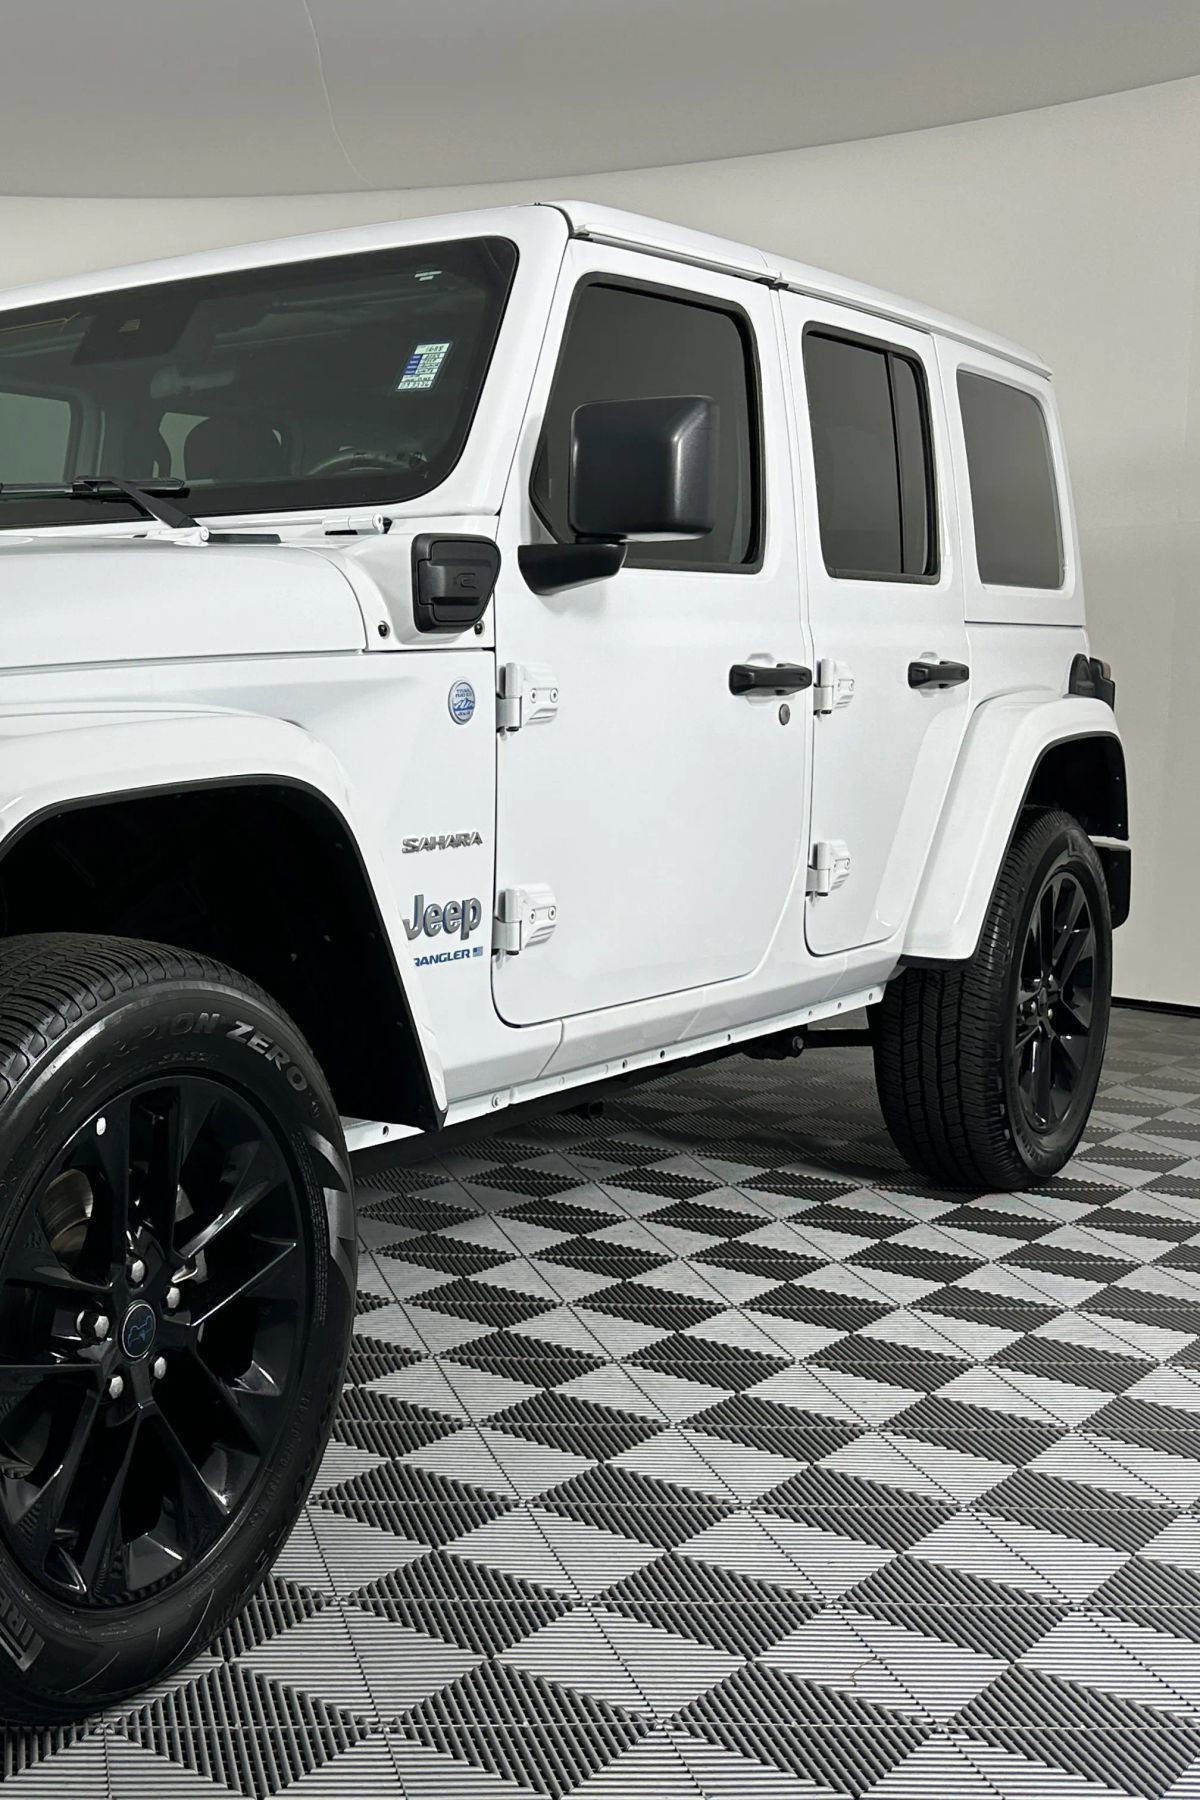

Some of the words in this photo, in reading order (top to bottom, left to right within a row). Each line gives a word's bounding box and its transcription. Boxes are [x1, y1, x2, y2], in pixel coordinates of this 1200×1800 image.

[402, 831, 483, 854] SAHARA
[402, 893, 482, 941] Jeep
[413, 949, 471, 967] RANGLER
[224, 1019, 308, 1092] ZERO
